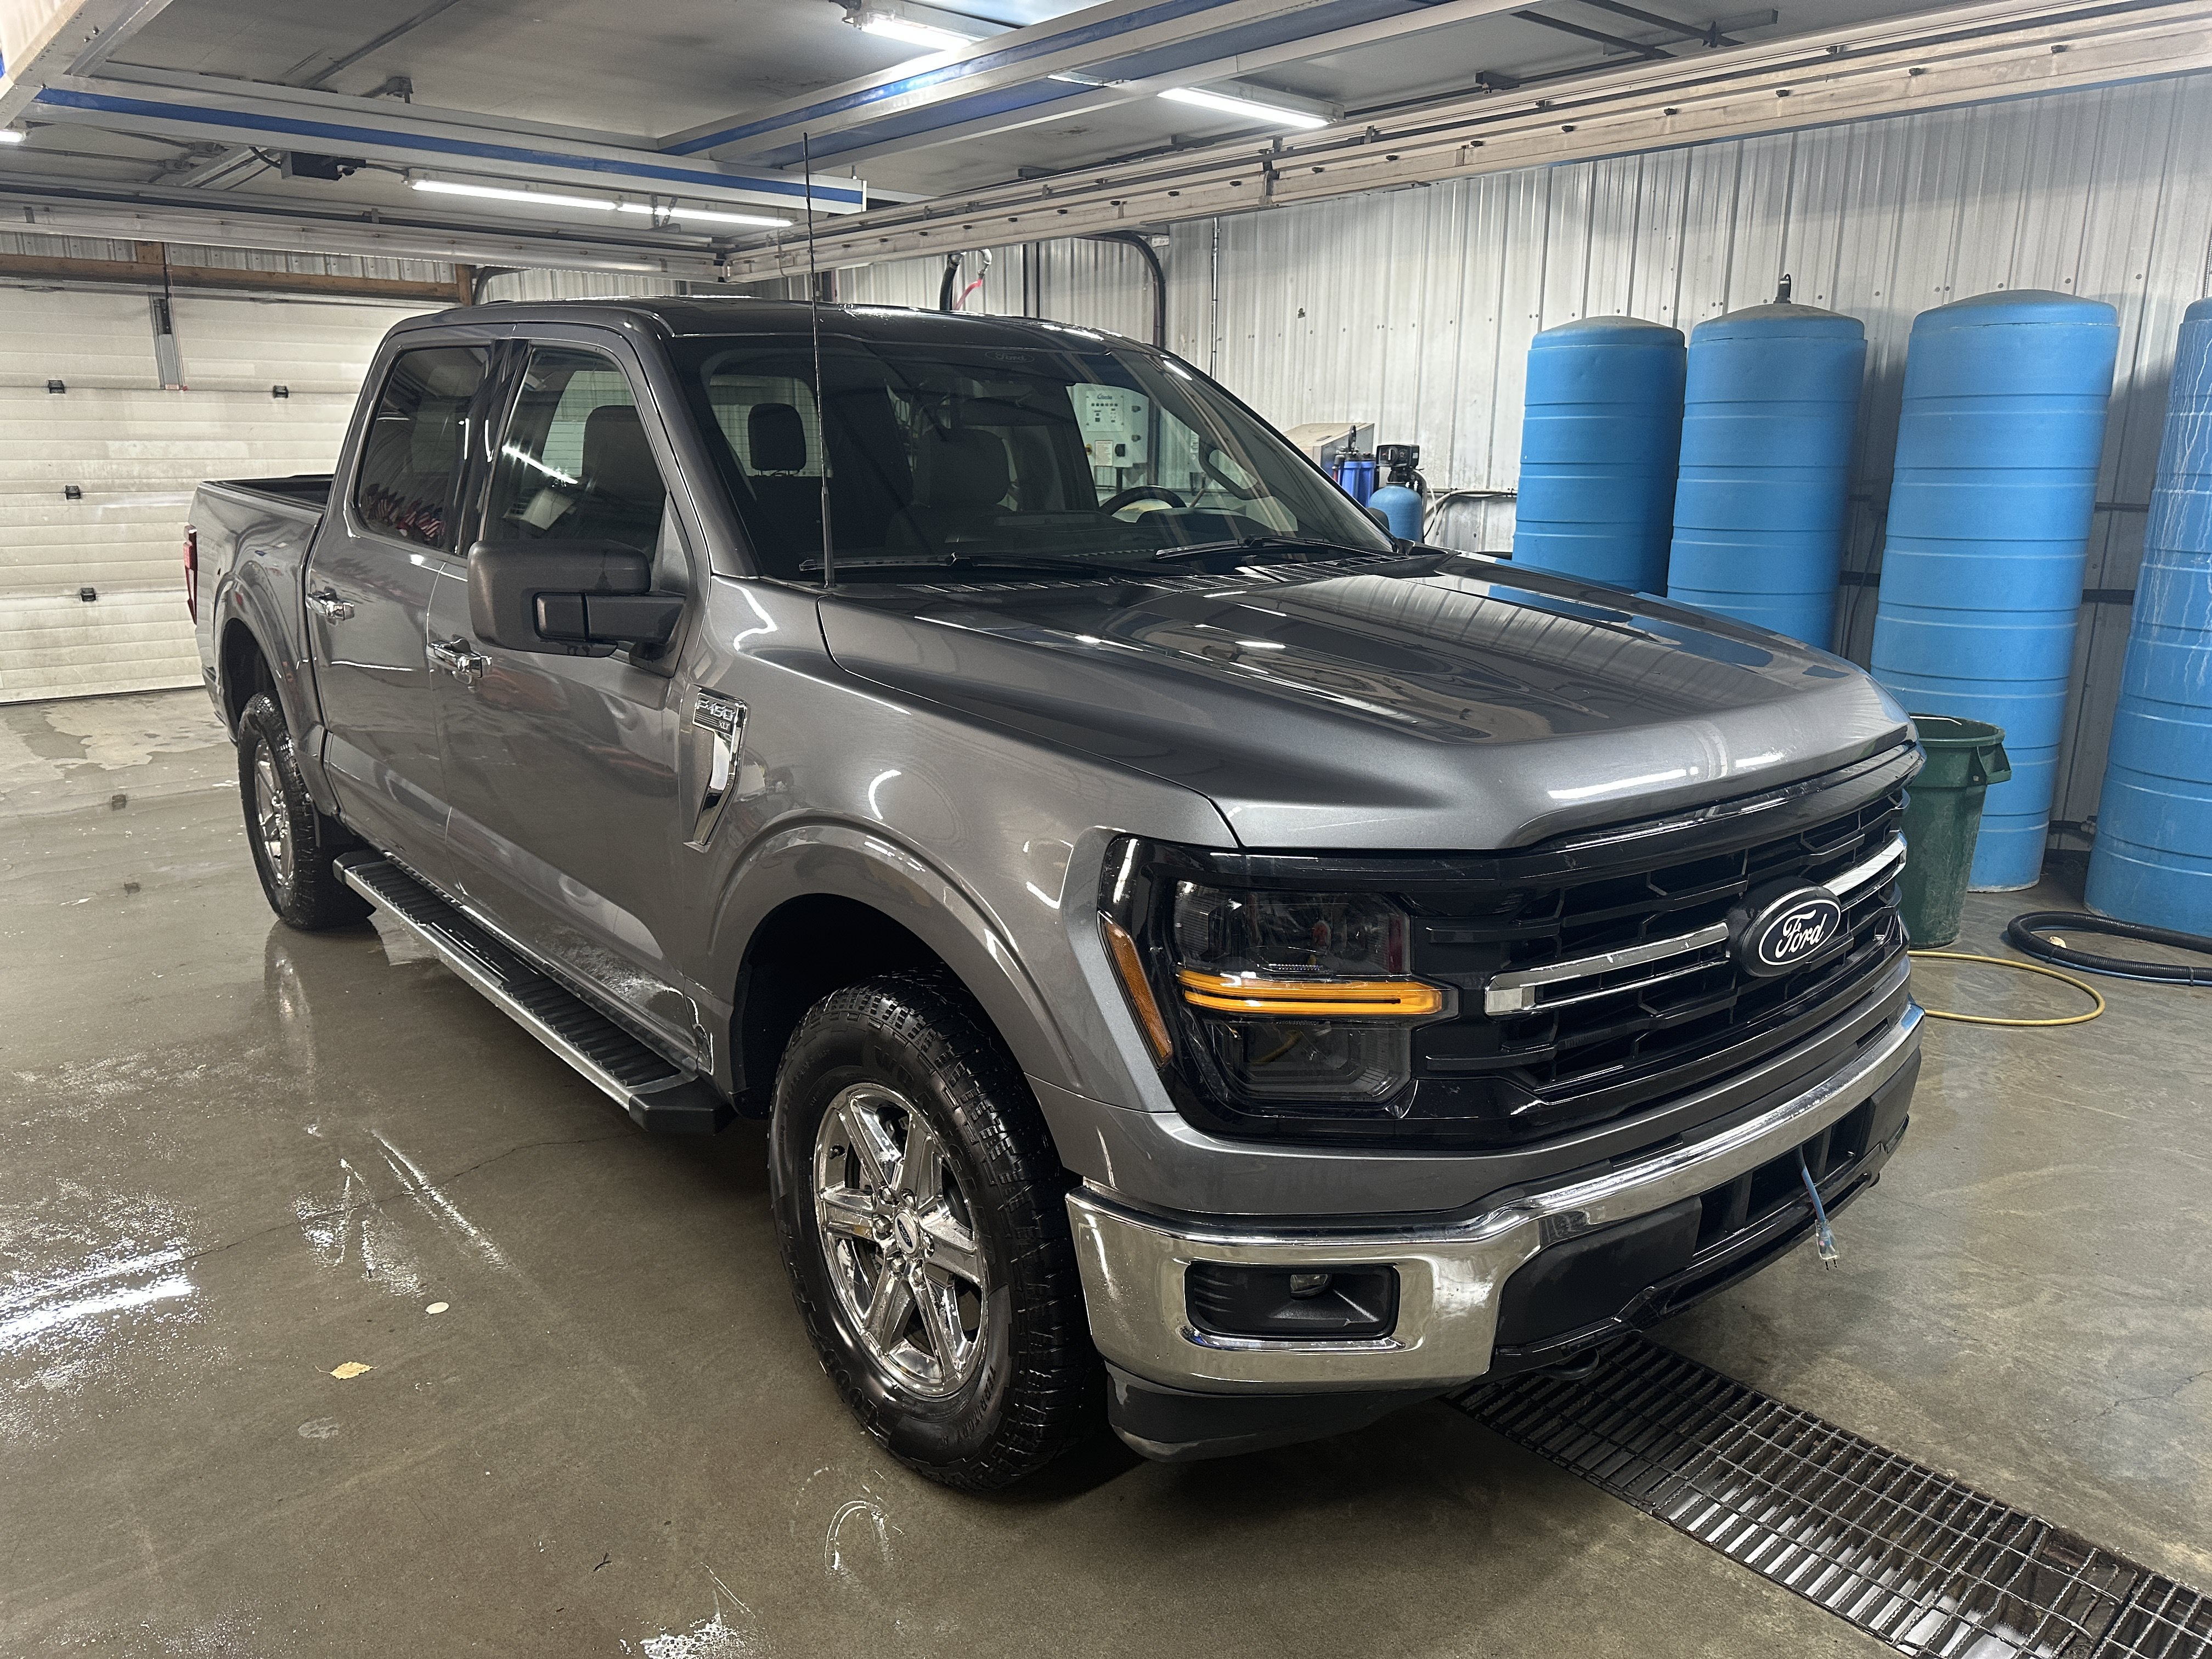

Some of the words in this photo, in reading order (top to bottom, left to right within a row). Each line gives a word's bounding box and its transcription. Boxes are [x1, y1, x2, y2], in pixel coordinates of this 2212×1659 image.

[995, 351, 1028, 361] Ford
[696, 699, 736, 721] F-150
[718, 721, 730, 730] XLT
[1775, 909, 1827, 958] Ford
[899, 1223, 911, 1243] Ford
[955, 1364, 997, 1444] TERRITORY
